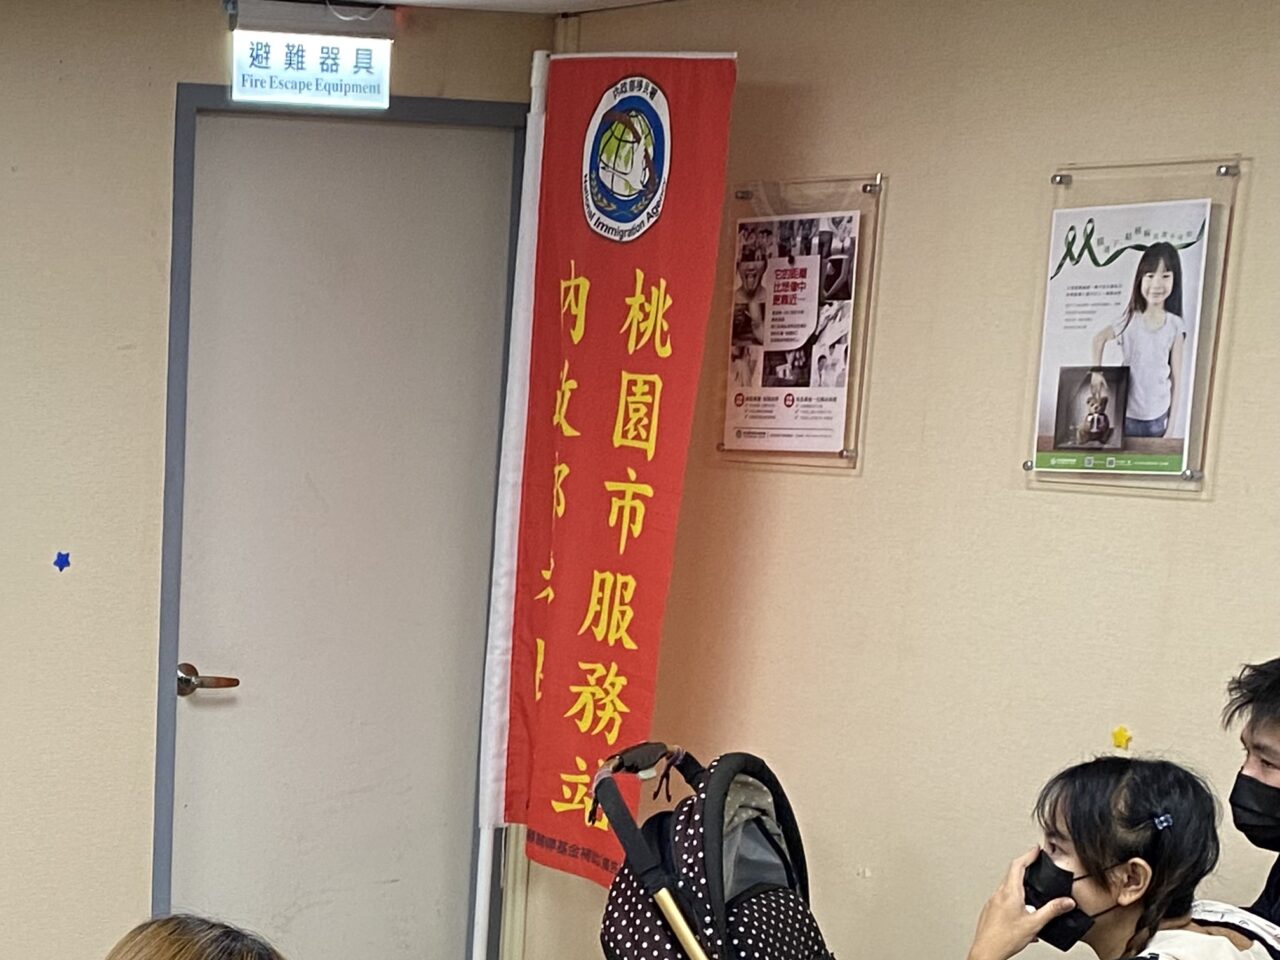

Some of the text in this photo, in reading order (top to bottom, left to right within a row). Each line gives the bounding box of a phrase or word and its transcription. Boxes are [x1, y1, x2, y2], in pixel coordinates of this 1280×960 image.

[249, 41, 374, 75] 避難器具
[241, 73, 381, 96] Fire Escape Equipment
